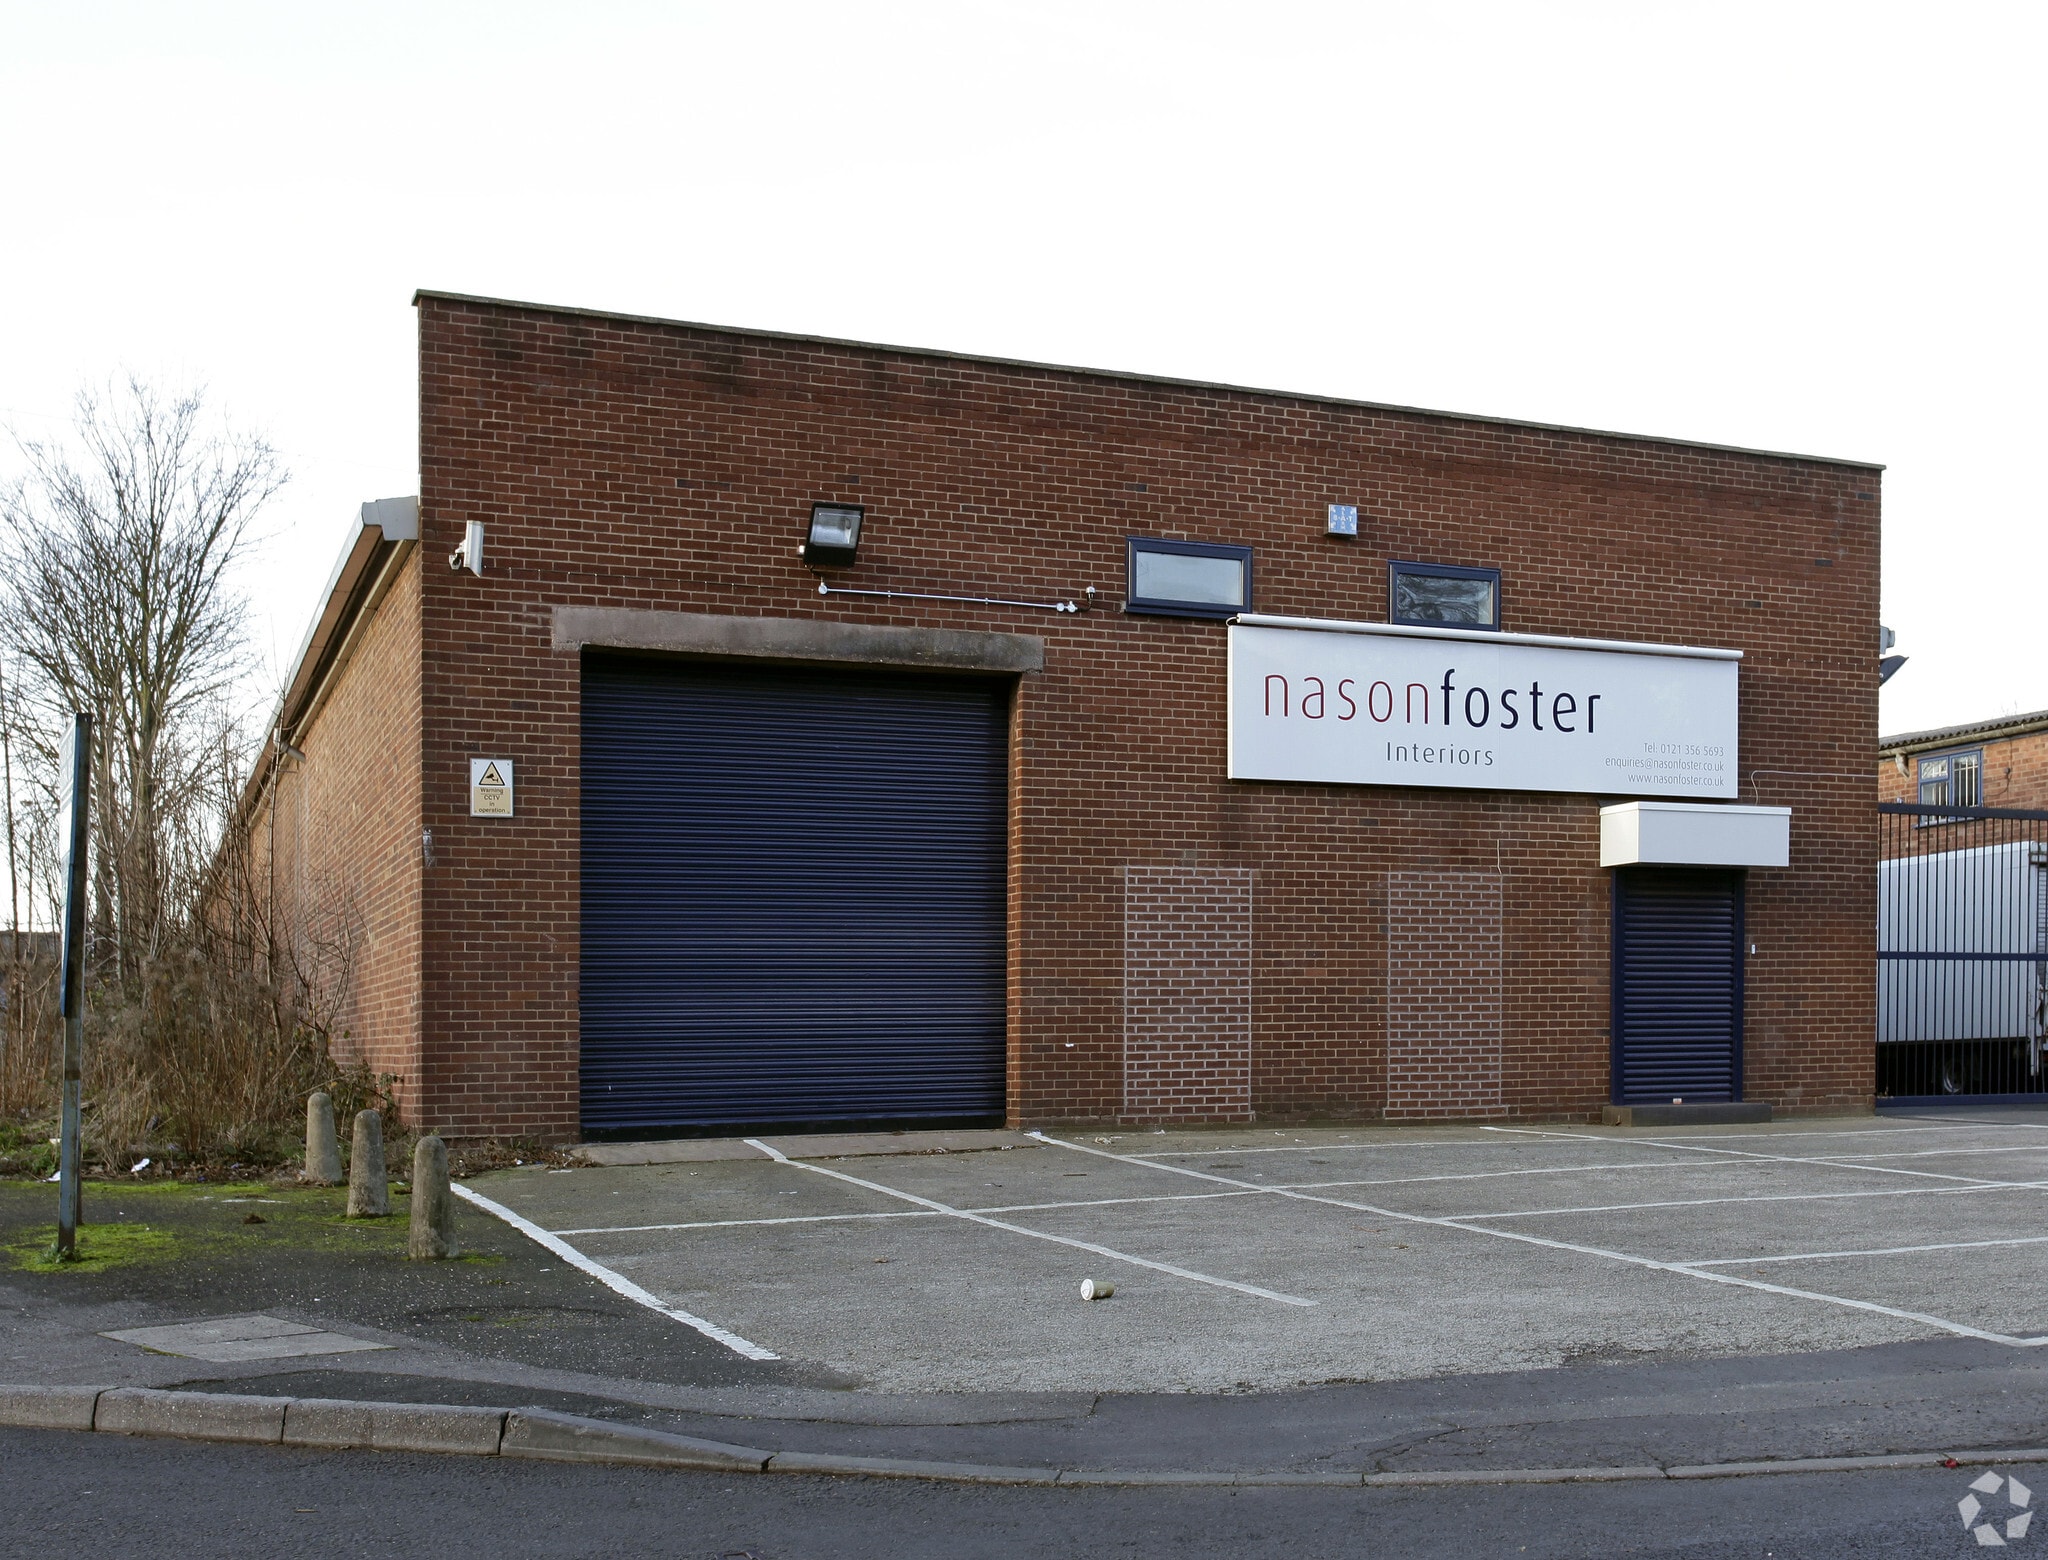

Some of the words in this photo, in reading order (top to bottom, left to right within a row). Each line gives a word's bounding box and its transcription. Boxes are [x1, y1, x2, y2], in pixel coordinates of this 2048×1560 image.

[1264, 668, 1601, 734] nasonfoster
[1386, 741, 1494, 766] Interiors
[1643, 742, 1658, 754] Tel:
[1660, 743, 1681, 755] 0121
[1684, 744, 1701, 756] 356
[1703, 745, 1725, 757] 5693
[1605, 757, 1725, 772] enquiries@nasonfoster.co.uk
[1627, 773, 1725, 787] www.nasonfoster.co.uk
[480, 787, 504, 795] Warning
